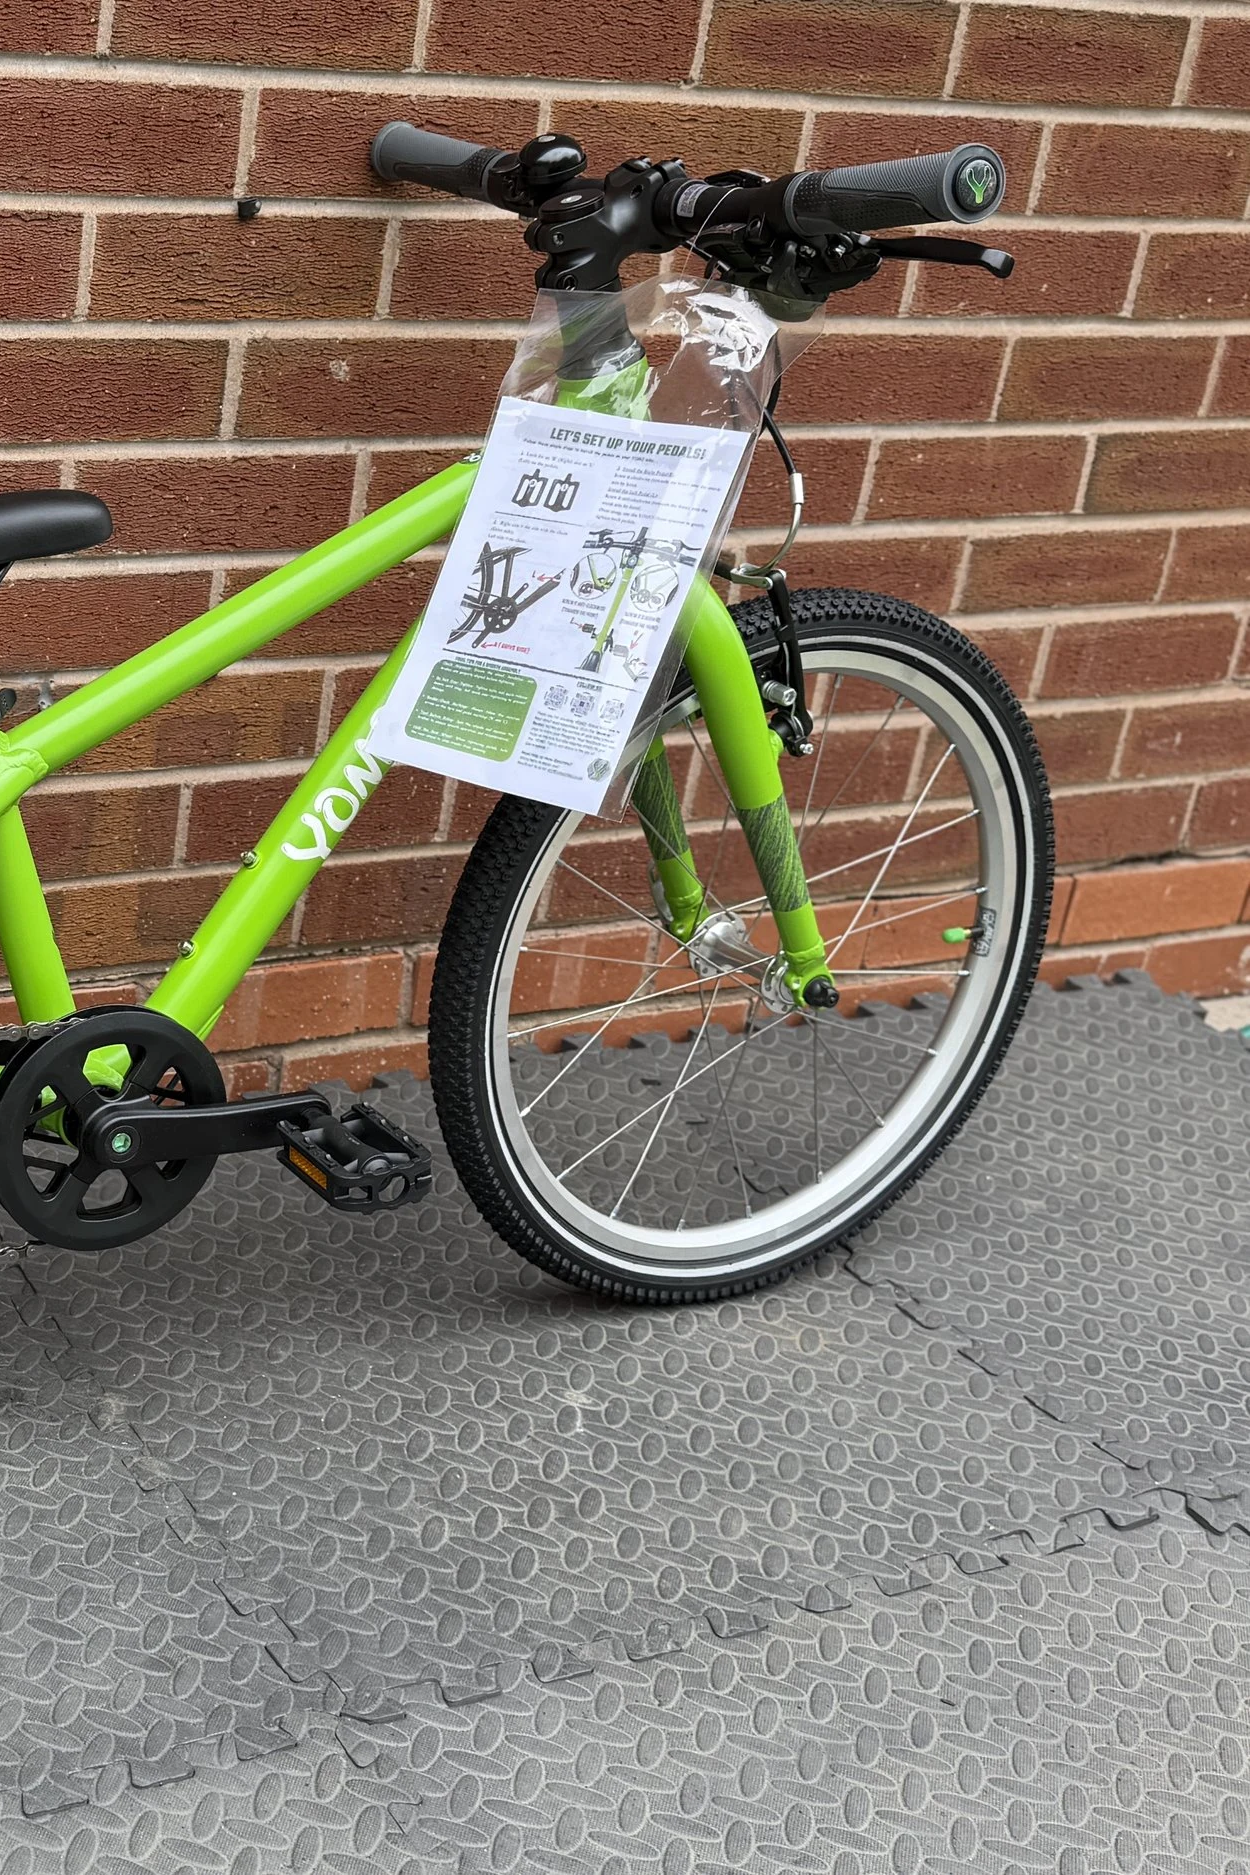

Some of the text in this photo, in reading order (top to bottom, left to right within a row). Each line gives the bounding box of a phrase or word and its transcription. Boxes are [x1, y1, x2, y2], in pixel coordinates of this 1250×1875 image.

[550, 427, 582, 443] LET'S
[582, 432, 606, 447] SET
[606, 437, 624, 450] UP
[625, 440, 656, 454] YOUR
[656, 444, 707, 460] PEDALS!
[281, 708, 395, 860] YOM
